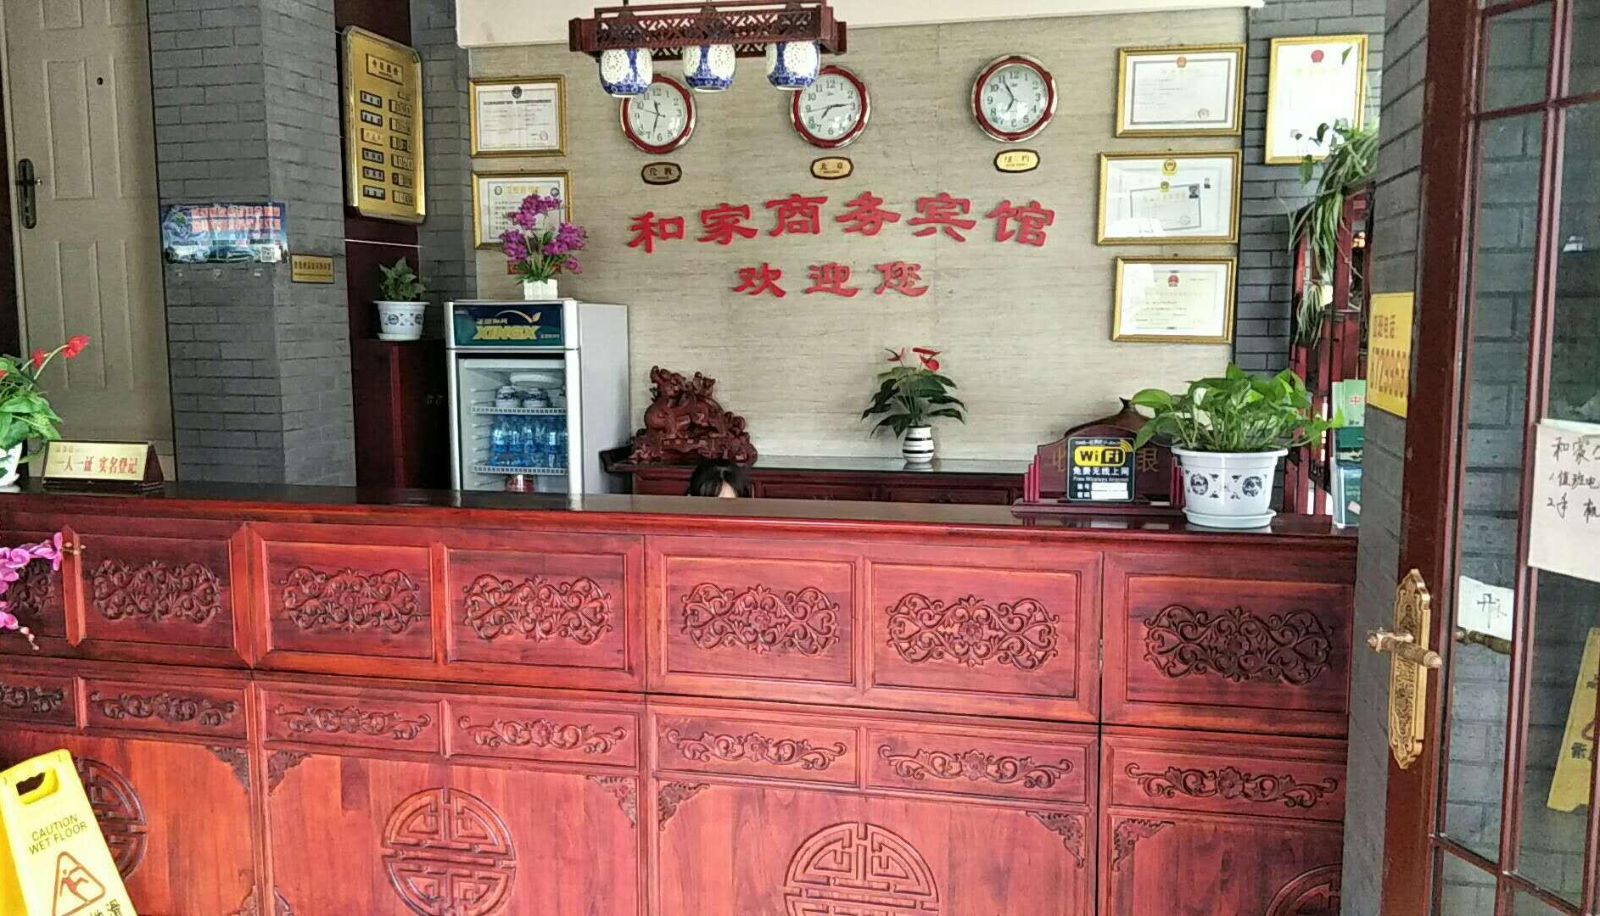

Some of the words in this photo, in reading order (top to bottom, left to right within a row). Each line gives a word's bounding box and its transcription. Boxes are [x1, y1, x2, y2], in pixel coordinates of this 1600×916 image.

[627, 191, 1056, 254] 和家商务宾馆
[732, 261, 930, 298] 欢迎您
[56, 455, 95, 472] 一人一证
[99, 456, 139, 475] 实名登记
[1079, 449, 1121, 463] WiFi
[1072, 466, 1130, 476] 免费无线上网
[28, 839, 54, 856] WET
[53, 821, 88, 844] FLOOR
[31, 814, 79, 842] CAUTION
